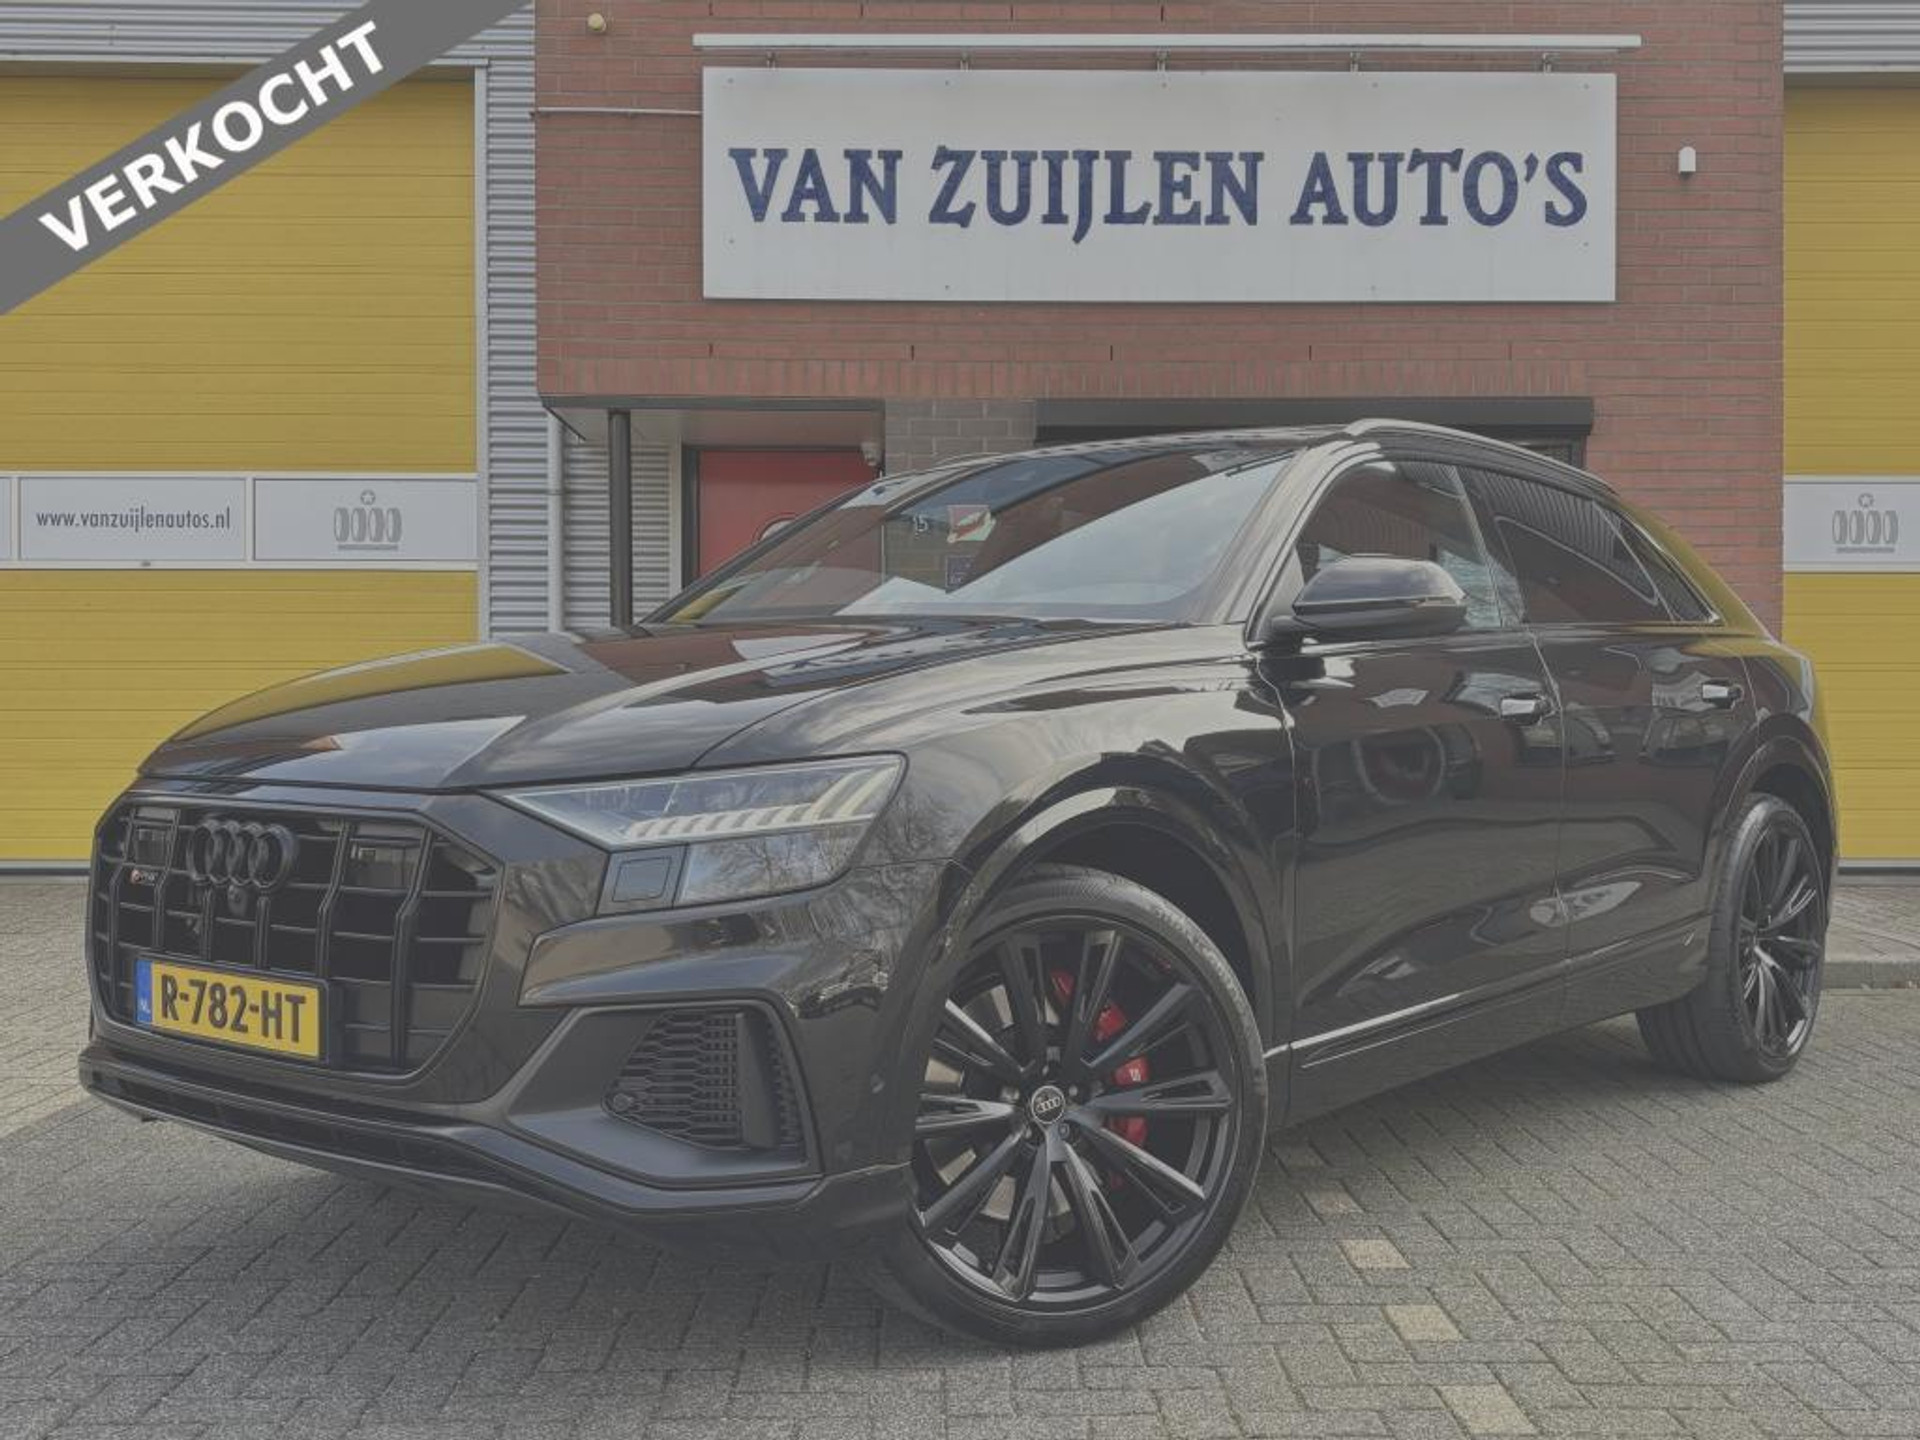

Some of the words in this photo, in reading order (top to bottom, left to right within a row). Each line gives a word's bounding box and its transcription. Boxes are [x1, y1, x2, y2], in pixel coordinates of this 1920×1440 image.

[728, 147, 904, 226] VAN
[928, 145, 1265, 245] ZUIJLEN
[1289, 148, 1588, 228] AUTO'S
[36, 505, 230, 533] www.vanzuijlenautos.nl
[160, 973, 307, 1043] R-782-HT
